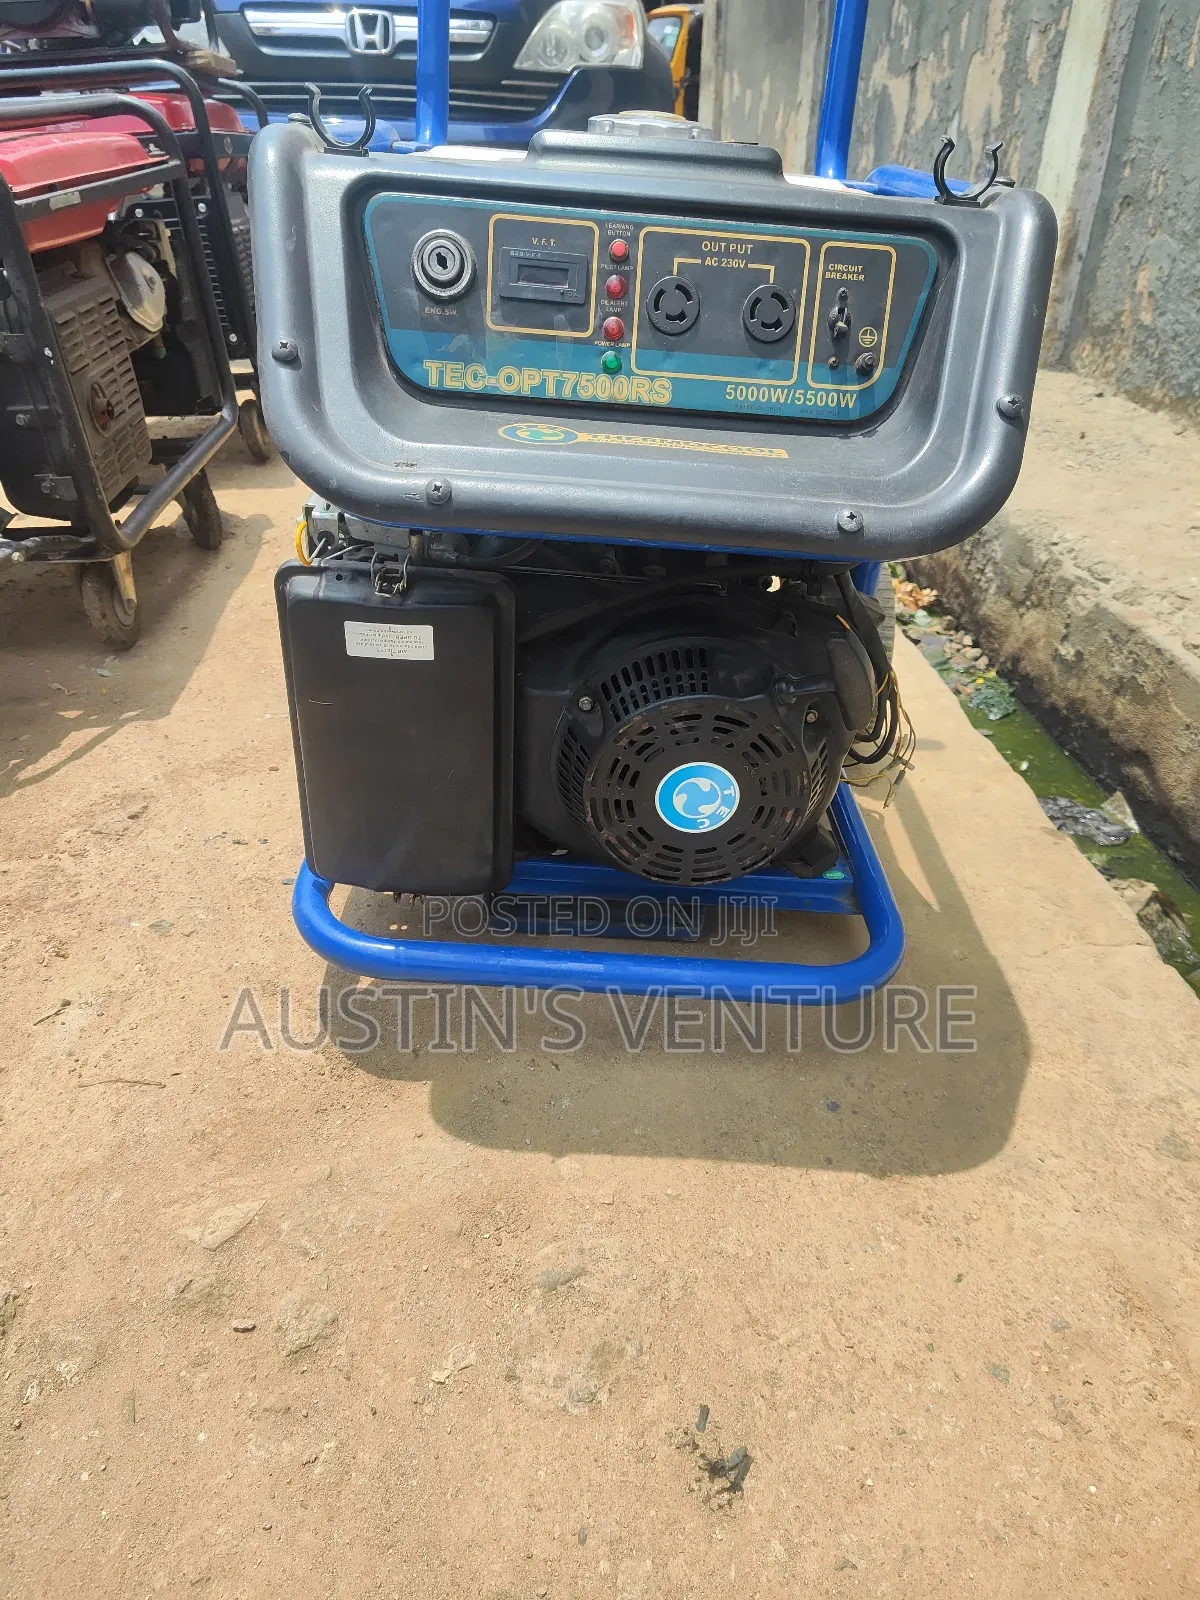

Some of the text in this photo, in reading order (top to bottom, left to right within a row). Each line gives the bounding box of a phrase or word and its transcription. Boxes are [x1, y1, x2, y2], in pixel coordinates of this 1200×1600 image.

[605, 222, 635, 231] LEARNING
[704, 256, 746, 269] AC 230V
[828, 263, 864, 273] CIRCUIT
[825, 271, 865, 281] BREAKER
[423, 359, 672, 405] TEC-OPT7500RS
[725, 384, 858, 409] 5000W/5500W
[757, 404, 782, 413] OUTPUT
[697, 785, 736, 829] TEC
